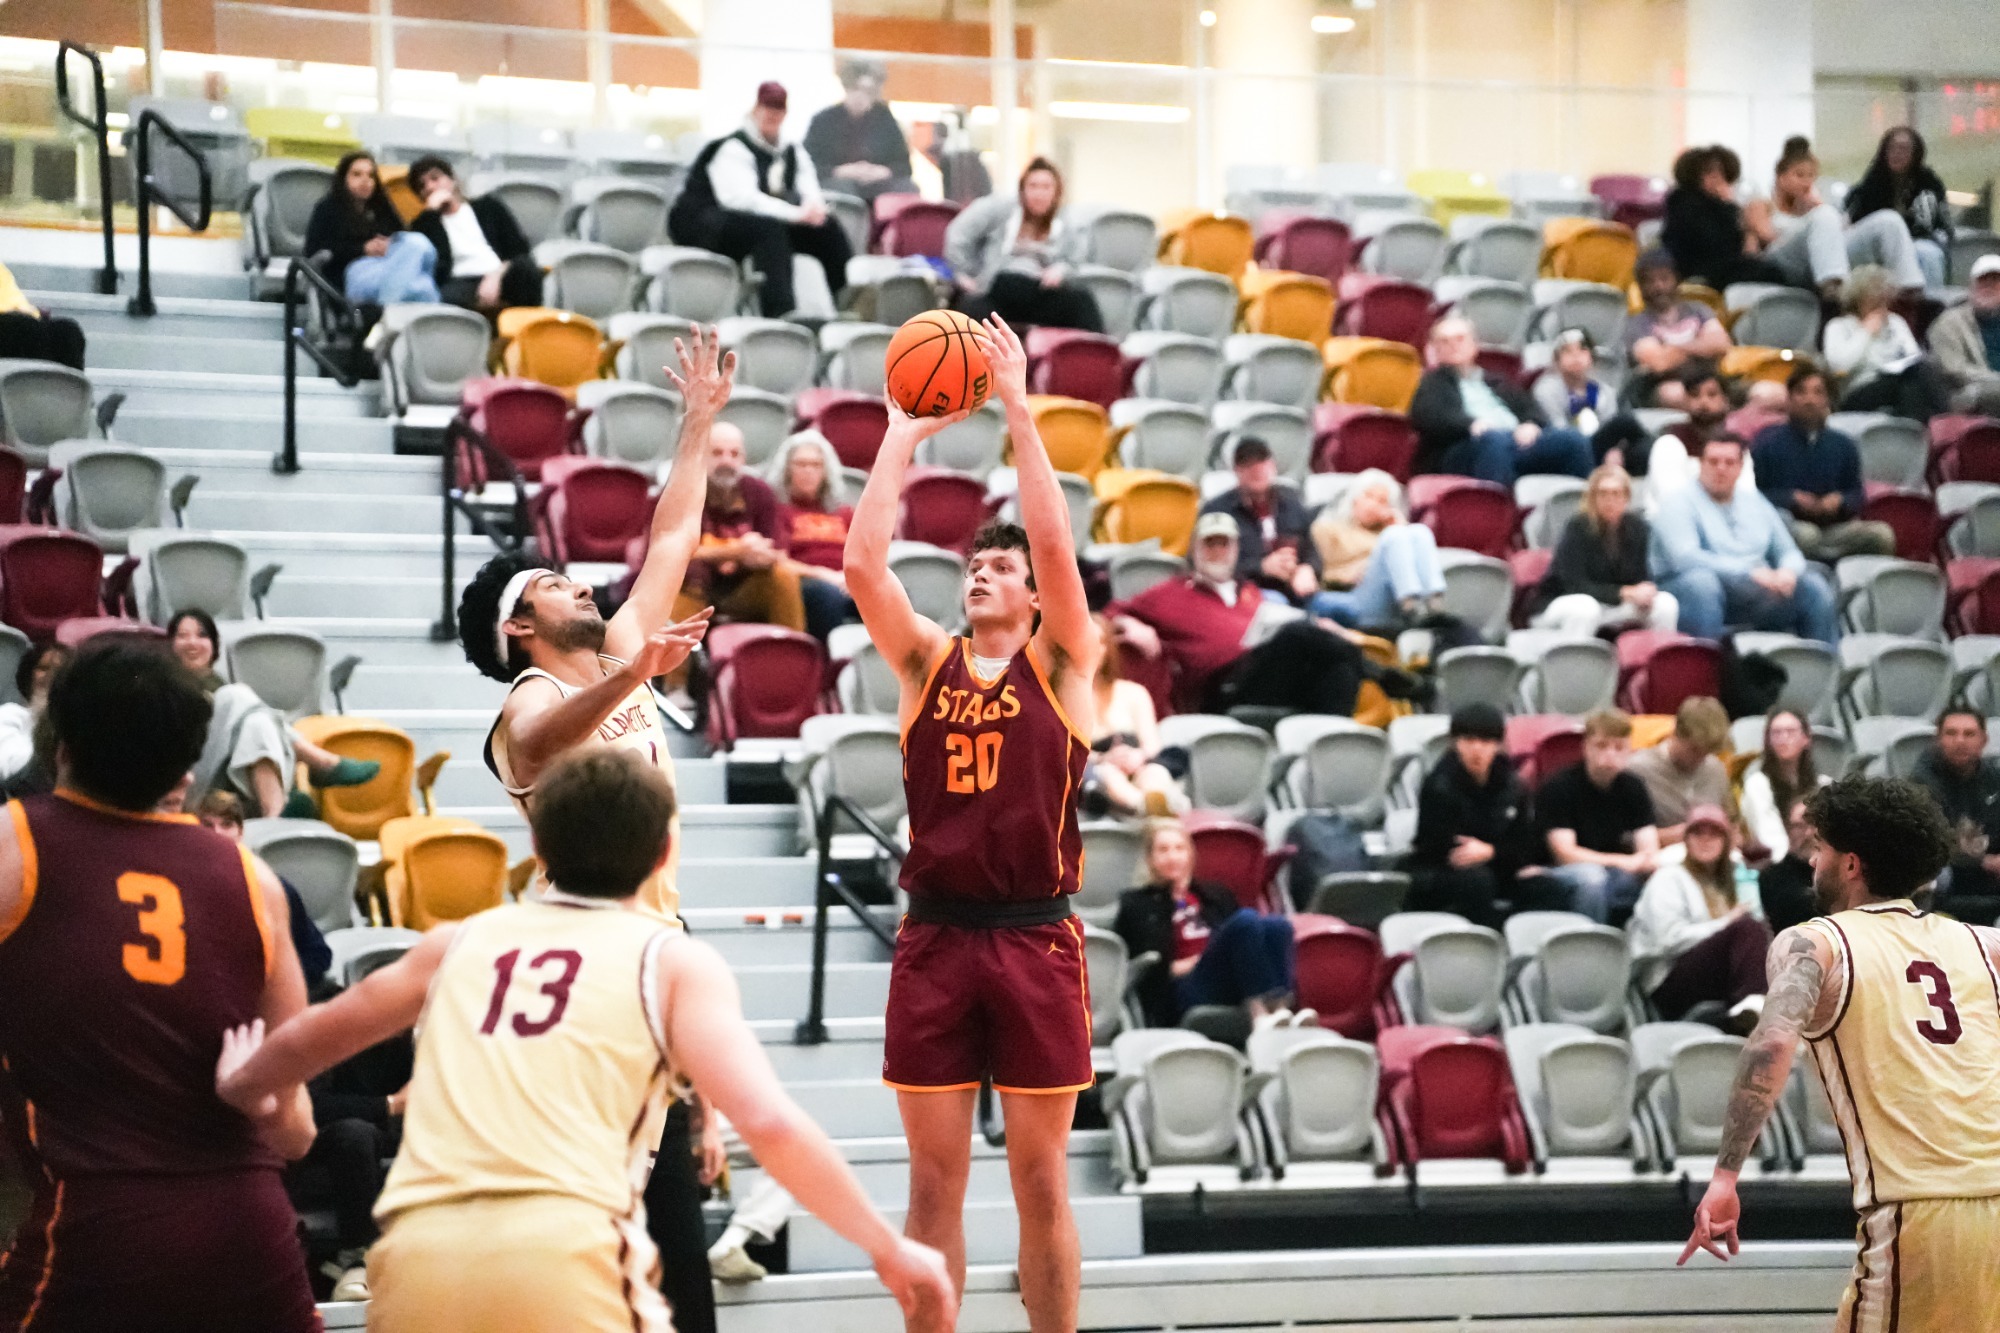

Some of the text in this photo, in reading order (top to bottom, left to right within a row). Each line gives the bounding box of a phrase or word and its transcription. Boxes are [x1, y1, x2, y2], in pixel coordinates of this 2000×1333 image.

[933, 684, 1021, 727] STAGS
[945, 731, 1004, 794] 20
[115, 870, 187, 986] 3
[480, 948, 583, 1038] 13
[1905, 959, 1963, 1045] 3
